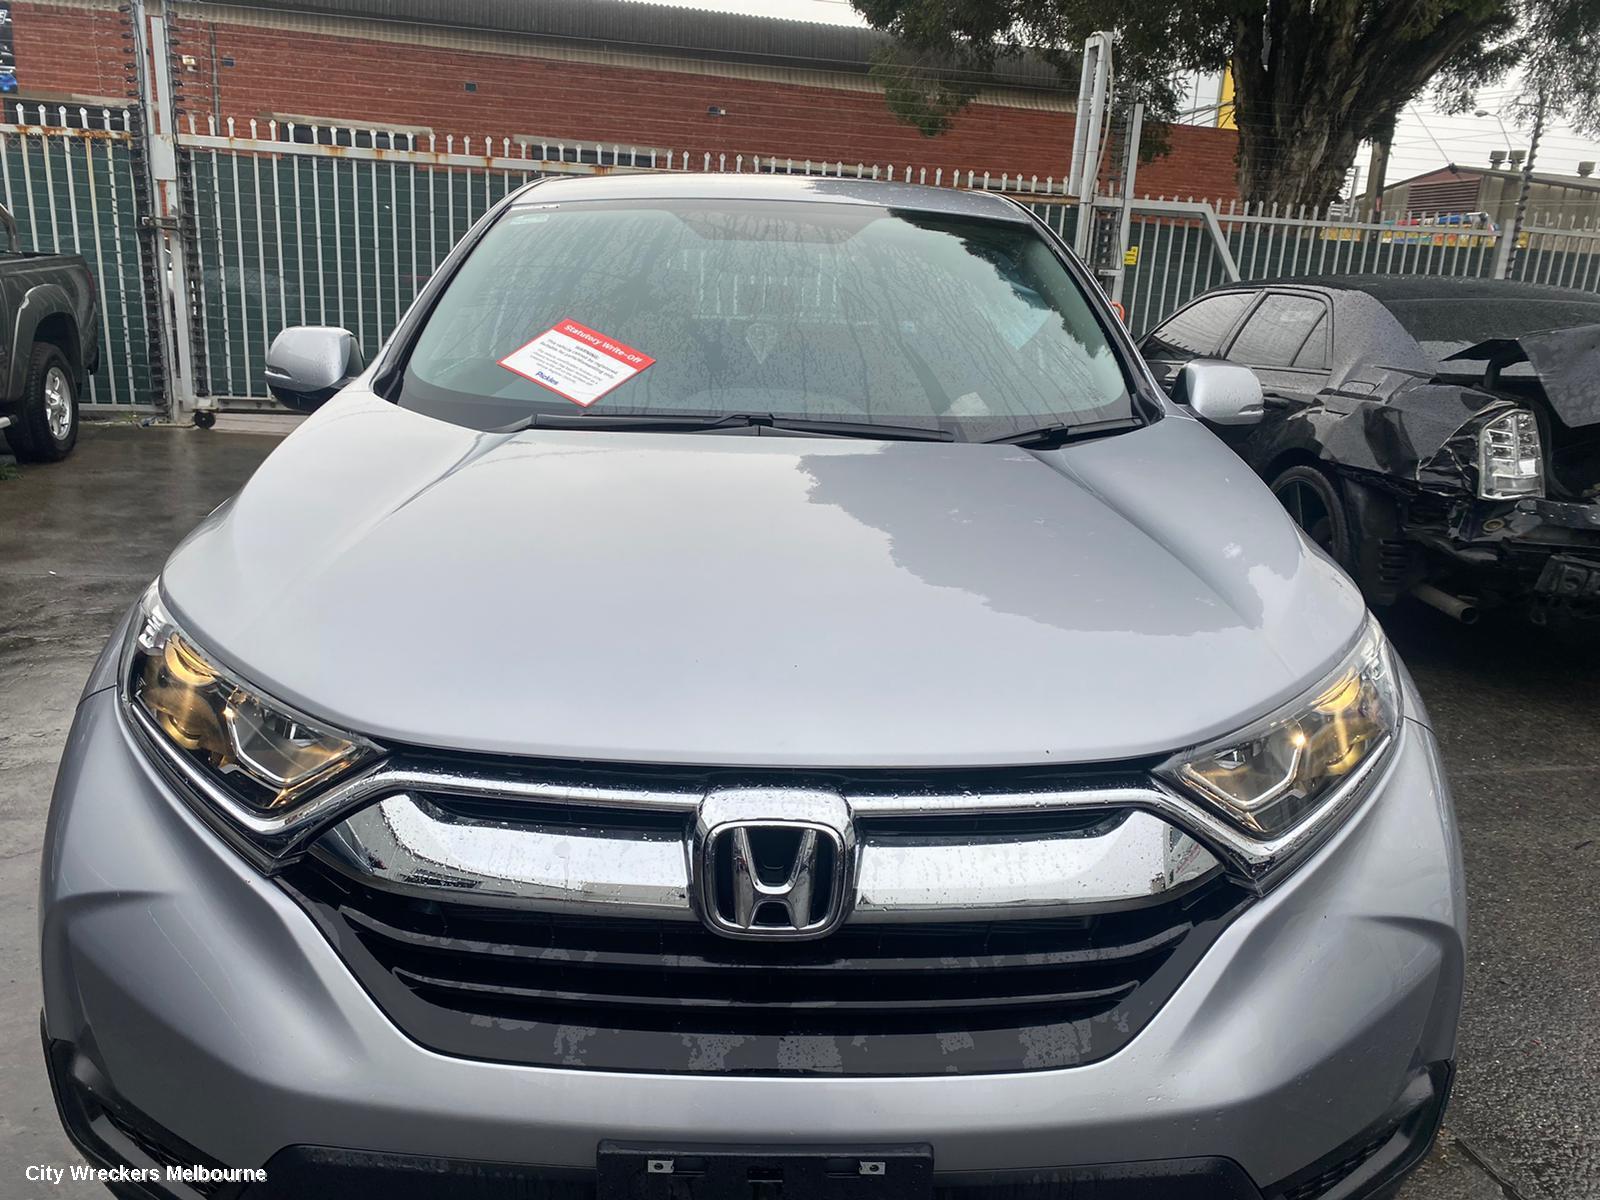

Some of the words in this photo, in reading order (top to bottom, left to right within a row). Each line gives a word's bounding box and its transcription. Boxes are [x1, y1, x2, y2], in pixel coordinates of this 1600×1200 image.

[564, 324, 602, 345] Statutory
[602, 341, 643, 363] Write-Off
[535, 370, 559, 386] Pickles
